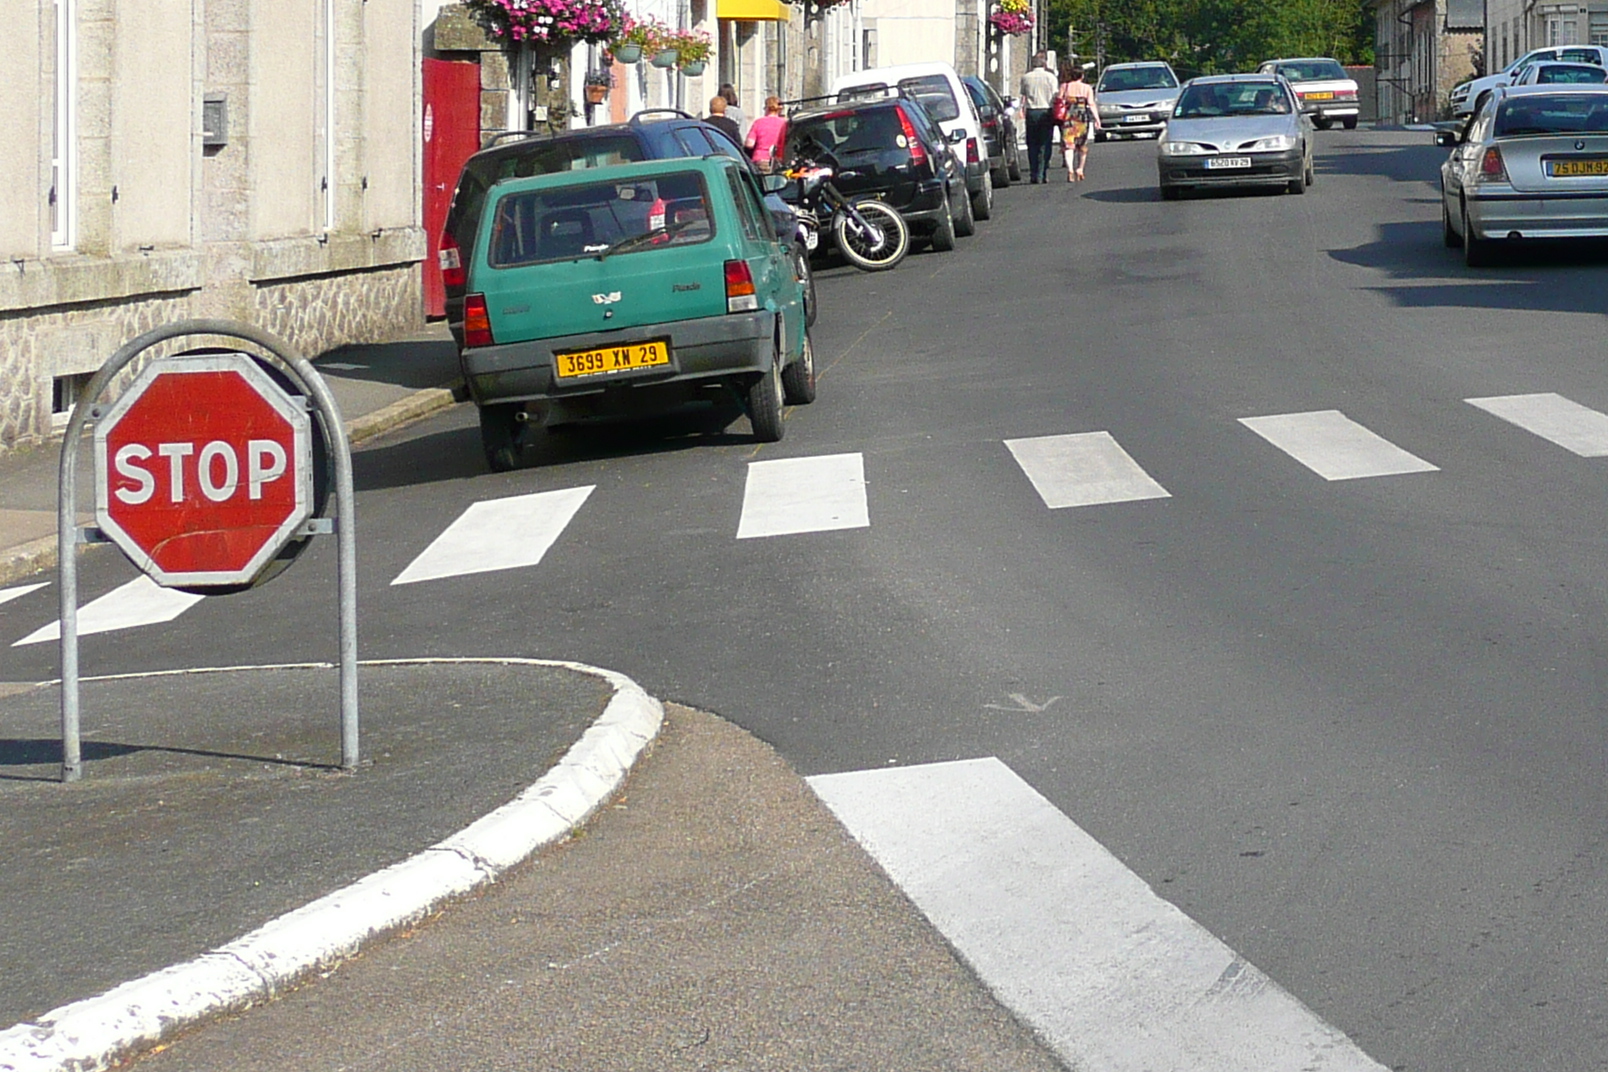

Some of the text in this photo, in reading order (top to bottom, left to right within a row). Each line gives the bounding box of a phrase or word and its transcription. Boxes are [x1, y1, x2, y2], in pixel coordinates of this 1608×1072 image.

[566, 352, 604, 373] 3699
[612, 349, 631, 366] XN
[639, 346, 658, 363] 29
[114, 439, 287, 505] STOP
